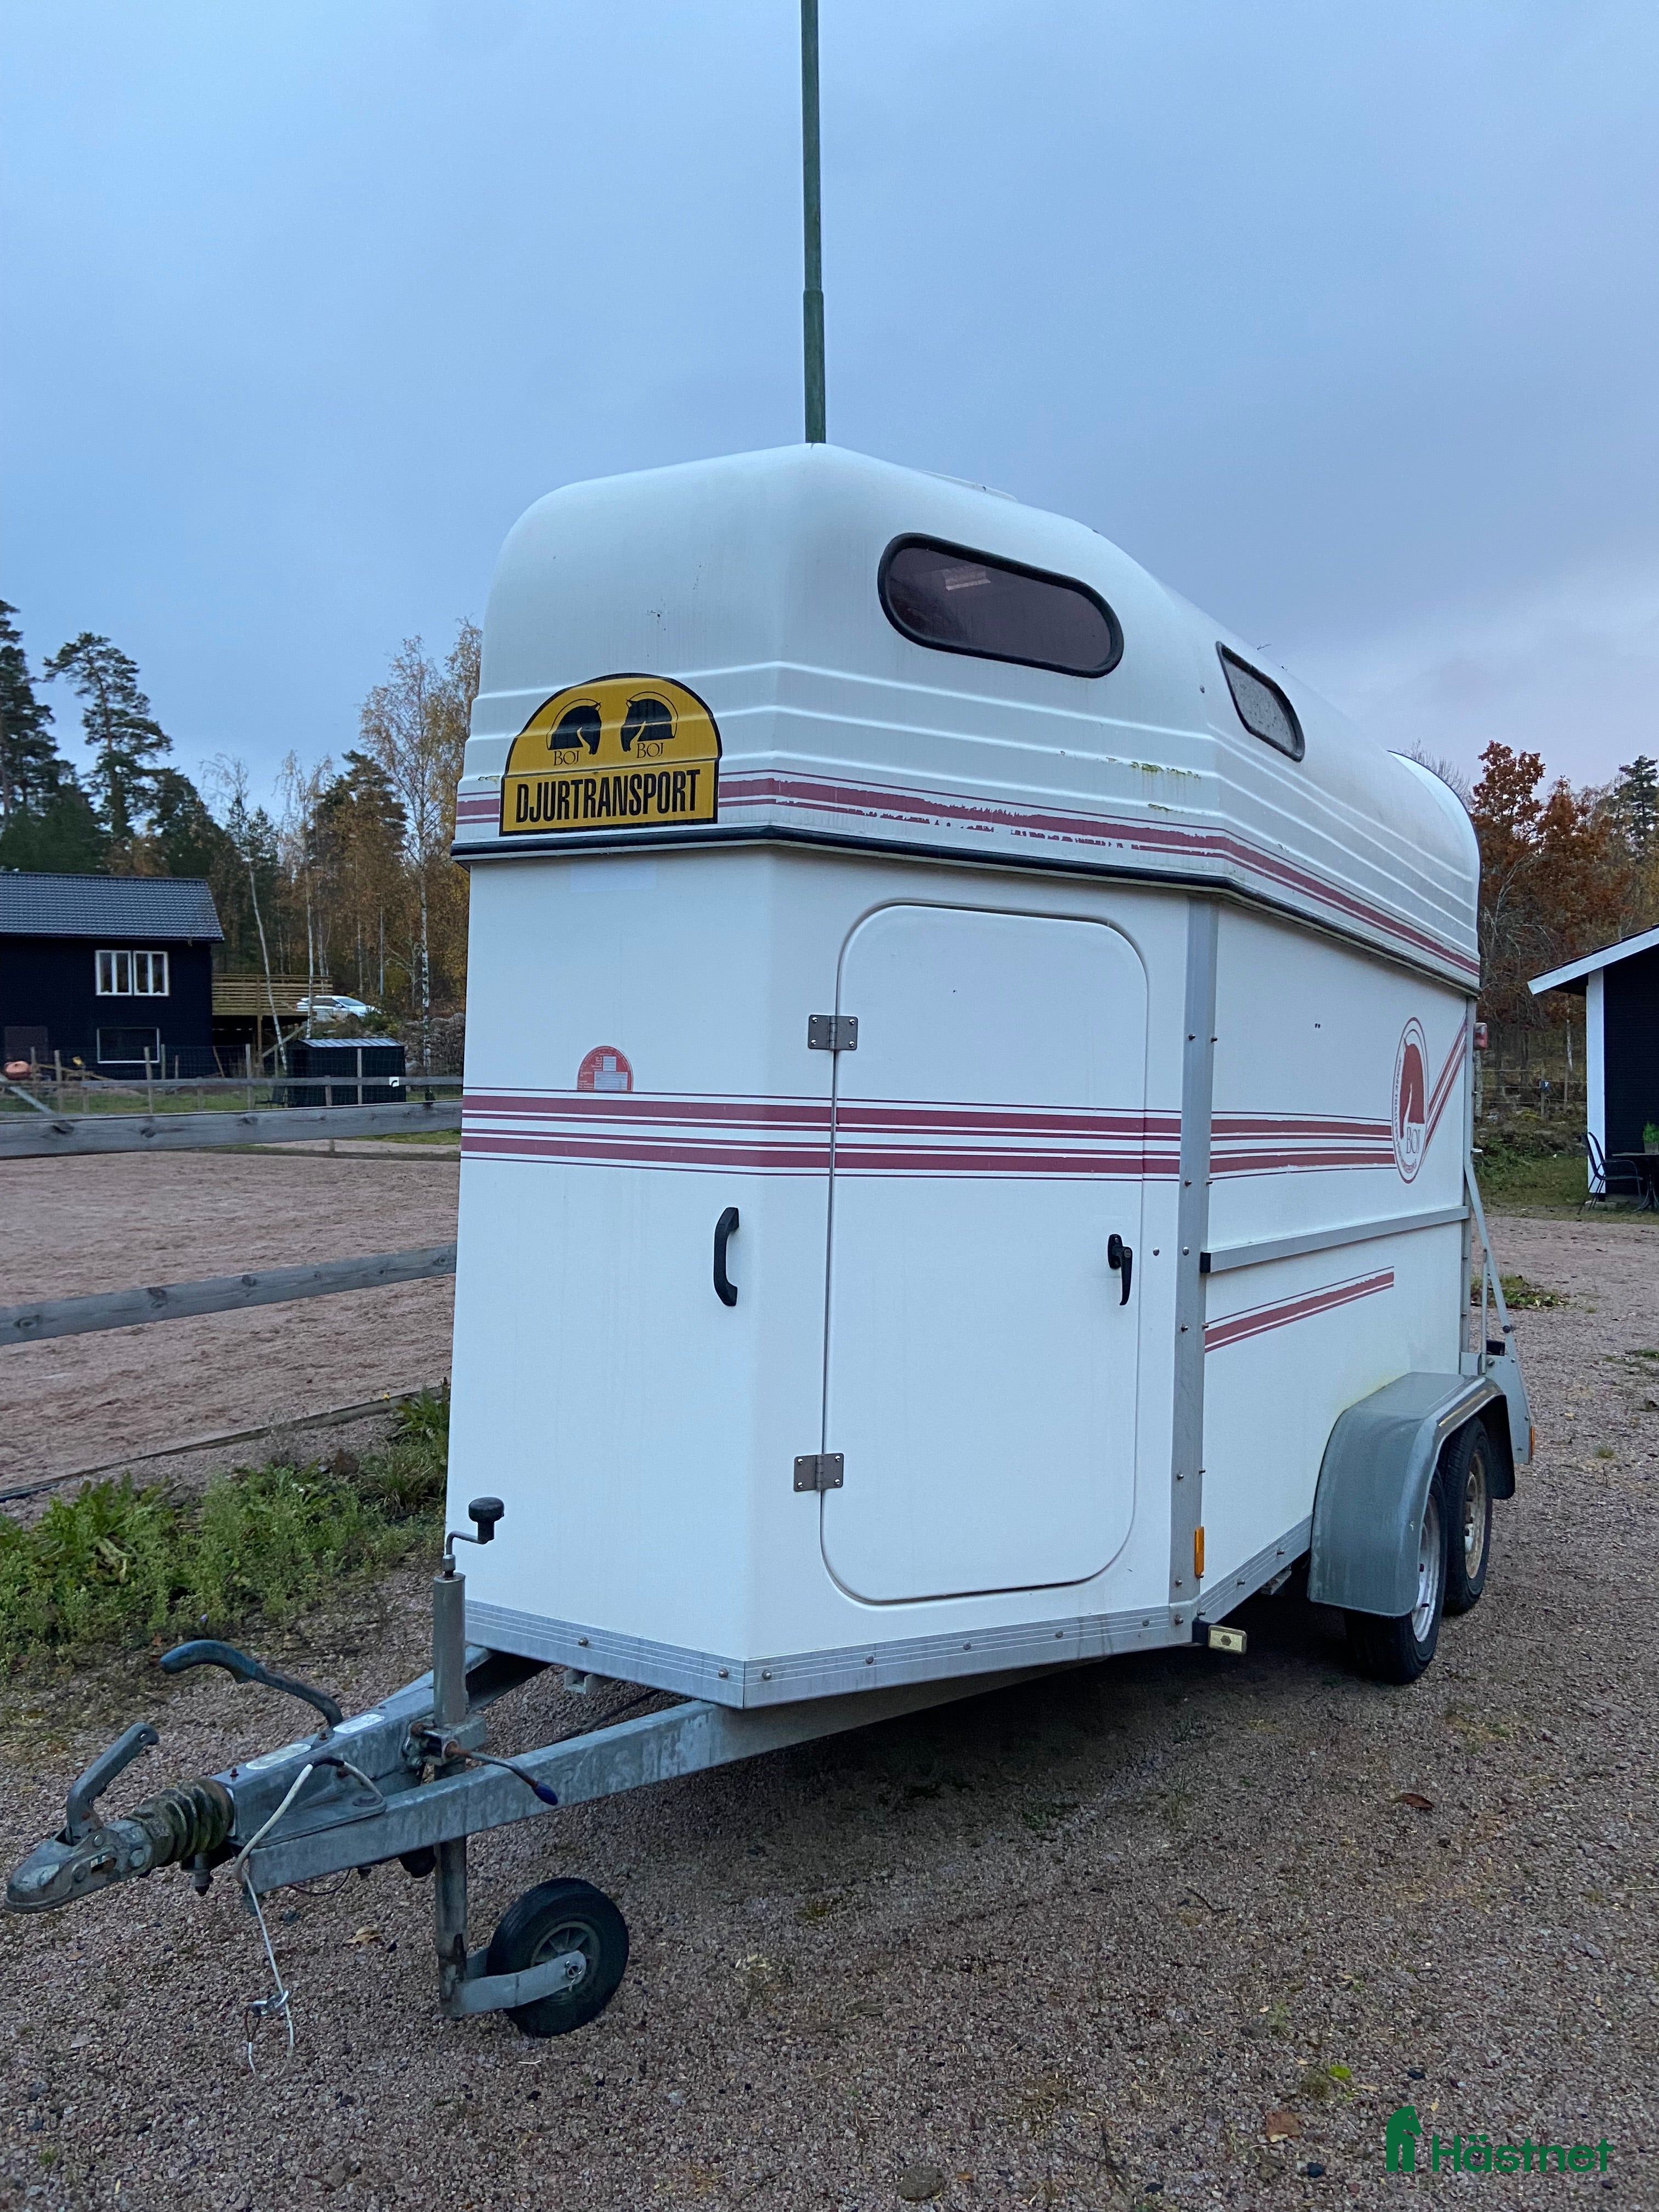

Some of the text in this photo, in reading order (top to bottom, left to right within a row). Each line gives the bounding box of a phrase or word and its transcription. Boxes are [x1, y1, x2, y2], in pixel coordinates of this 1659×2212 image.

[554, 750, 580, 766] BOJ
[636, 742, 664, 759] BOJ
[515, 769, 701, 823] DJURTRANSPORT
